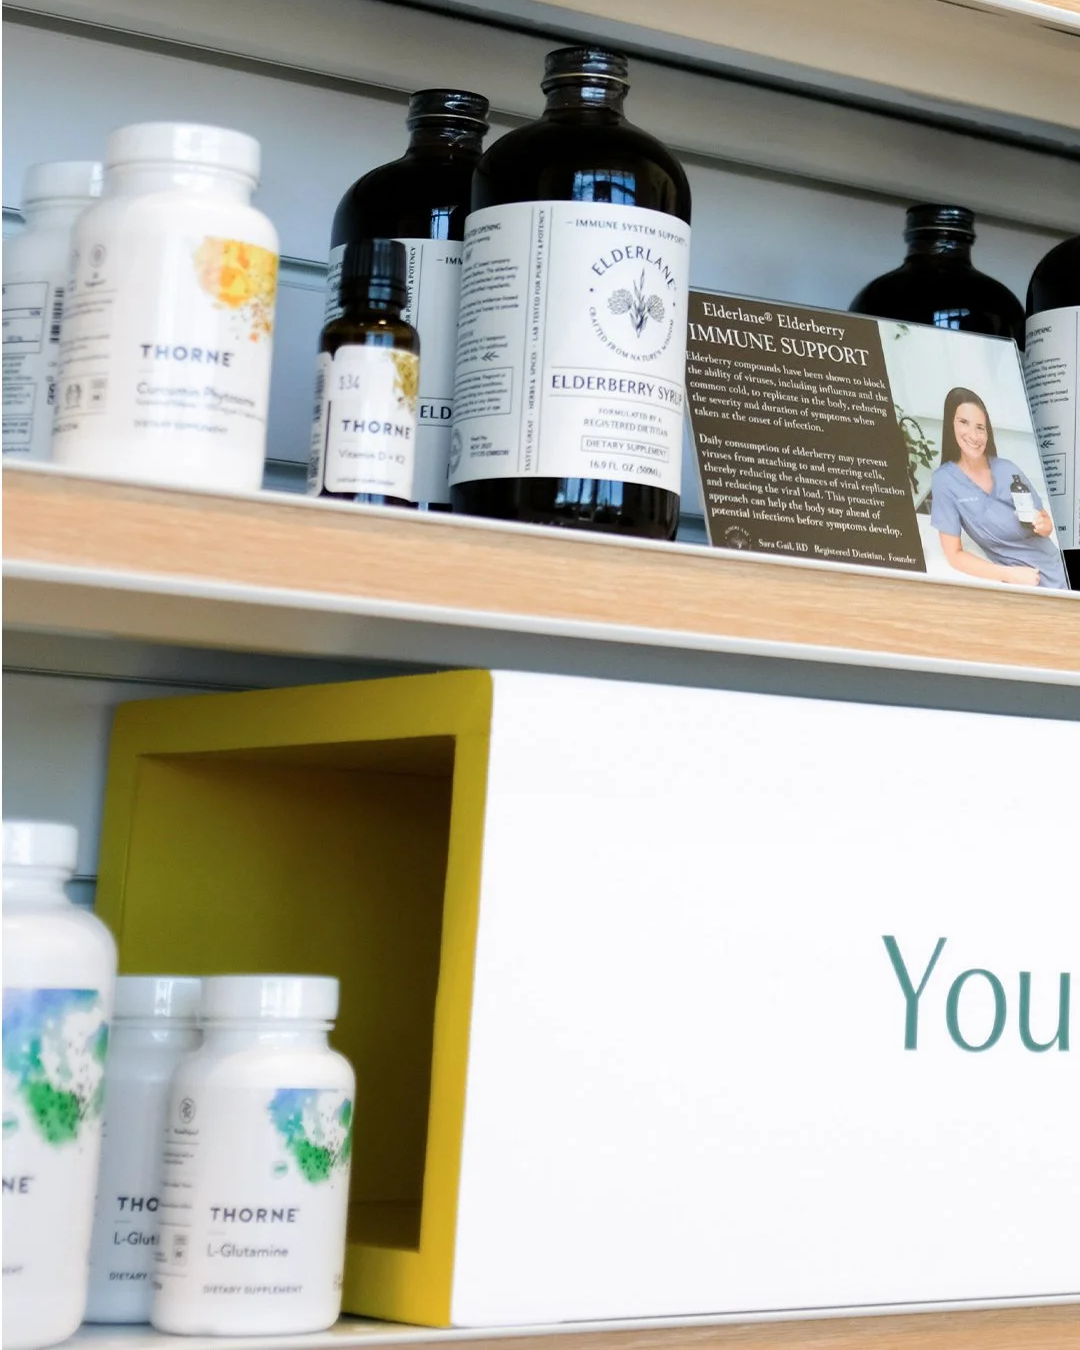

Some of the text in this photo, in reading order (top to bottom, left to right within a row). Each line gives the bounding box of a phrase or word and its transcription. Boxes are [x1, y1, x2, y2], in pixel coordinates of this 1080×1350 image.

[575, 219, 686, 246] IMMUNE SYSTEM SUPPORT
[591, 245, 676, 290] ELDERLANE
[776, 313, 844, 340] Elderberry
[140, 344, 231, 367] THORNE
[688, 322, 868, 365] IMMUNE SUPPORT
[552, 374, 655, 397] ELDERBERRY
[687, 364, 888, 402] the ability of viruses, including influenza and the
[733, 361, 781, 373] compounds
[782, 364, 801, 376] have
[803, 367, 823, 379] been
[825, 371, 851, 383] shown
[862, 377, 885, 389] block
[689, 381, 726, 391] common
[728, 384, 749, 395] cold,
[762, 390, 798, 402] replicate
[800, 394, 809, 403] in
[811, 395, 825, 405] the
[826, 397, 849, 411] body,
[851, 402, 887, 417] reducing
[692, 392, 874, 425] the severity and duration of symptoms when
[342, 419, 411, 439] THORNE
[694, 406, 718, 417] taken
[731, 411, 745, 421] the
[748, 416, 770, 424] onset
[772, 417, 782, 426] of
[783, 419, 823, 431] infection.
[586, 438, 666, 457] DIETARY SUPPLEMENT
[699, 433, 887, 466] Daily consumption of elderberry may prevent
[701, 449, 731, 460] viruses
[734, 451, 754, 463] from
[757, 457, 797, 471] attaching
[809, 463, 825, 472] and
[827, 467, 862, 479] entering
[863, 470, 885, 480] cells,
[210, 1207, 296, 1223] THORNE
[207, 1243, 288, 1258] L-Glutamine
[109, 1273, 148, 1281] DIETARY
[203, 1285, 303, 1294] DIETARY SUPPLEMENT
